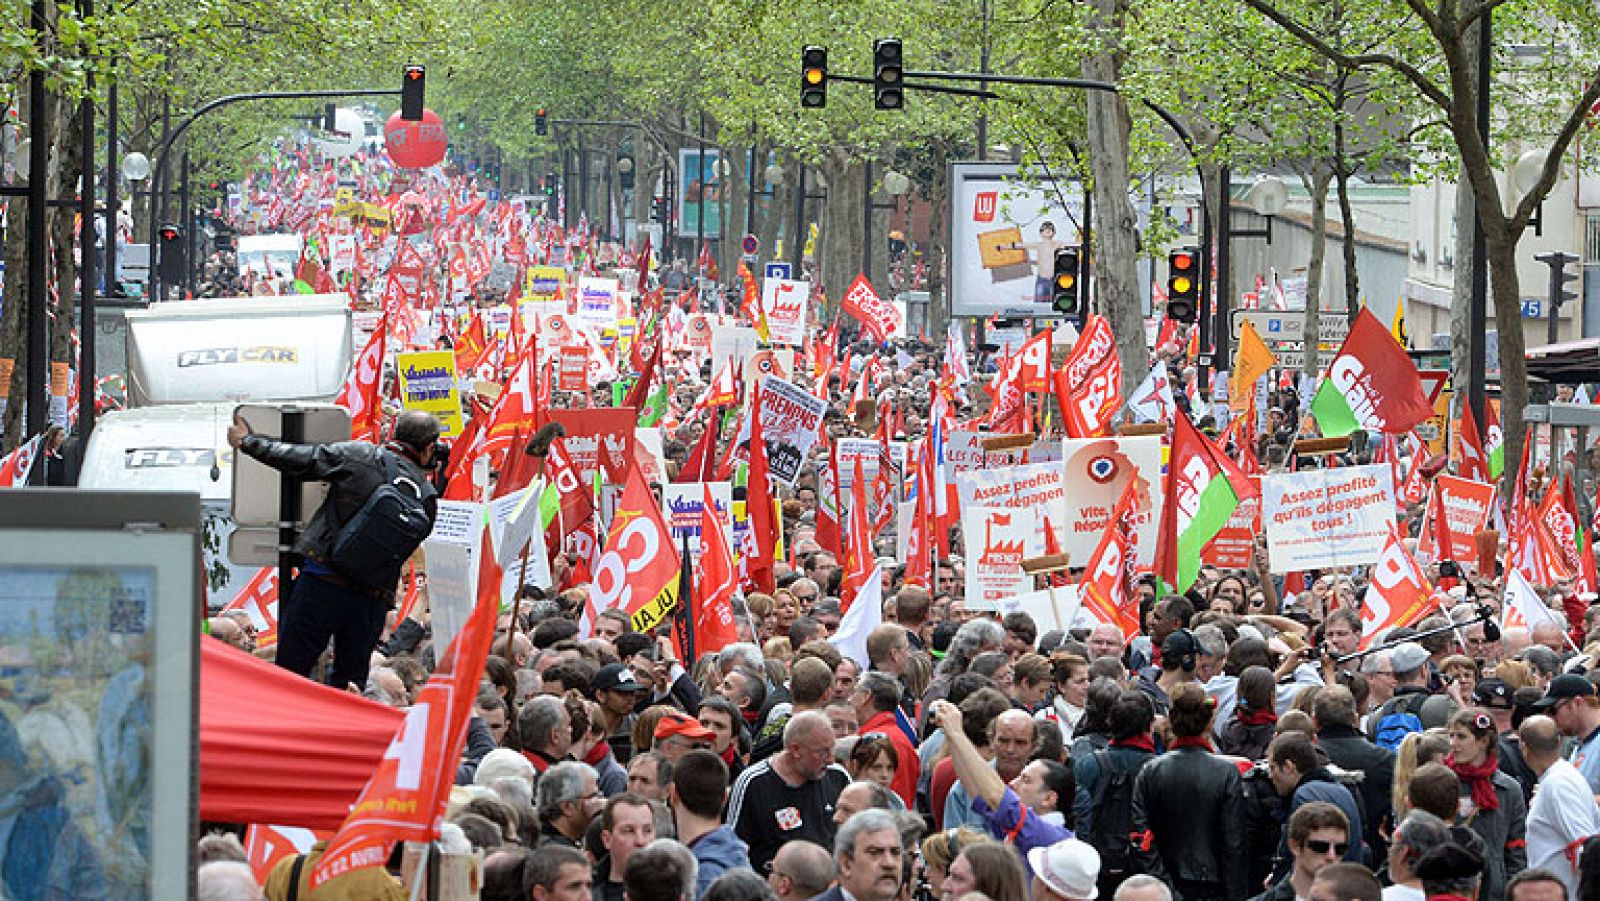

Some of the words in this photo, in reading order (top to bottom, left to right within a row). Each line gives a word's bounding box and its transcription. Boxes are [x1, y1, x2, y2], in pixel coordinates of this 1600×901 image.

[180, 349, 232, 367] FLY
[240, 348, 297, 363] CAR
[128, 450, 214, 468] FLY
[974, 482, 1011, 501] Assez
[1013, 469, 1060, 496] profité
[1281, 487, 1324, 506] Assez
[1326, 473, 1377, 499] profité
[1005, 486, 1064, 508] dégagen
[1274, 505, 1313, 525] qu'ils
[1316, 489, 1387, 515] dégagent
[1311, 517, 1344, 532] tous
[1346, 512, 1353, 525] !
